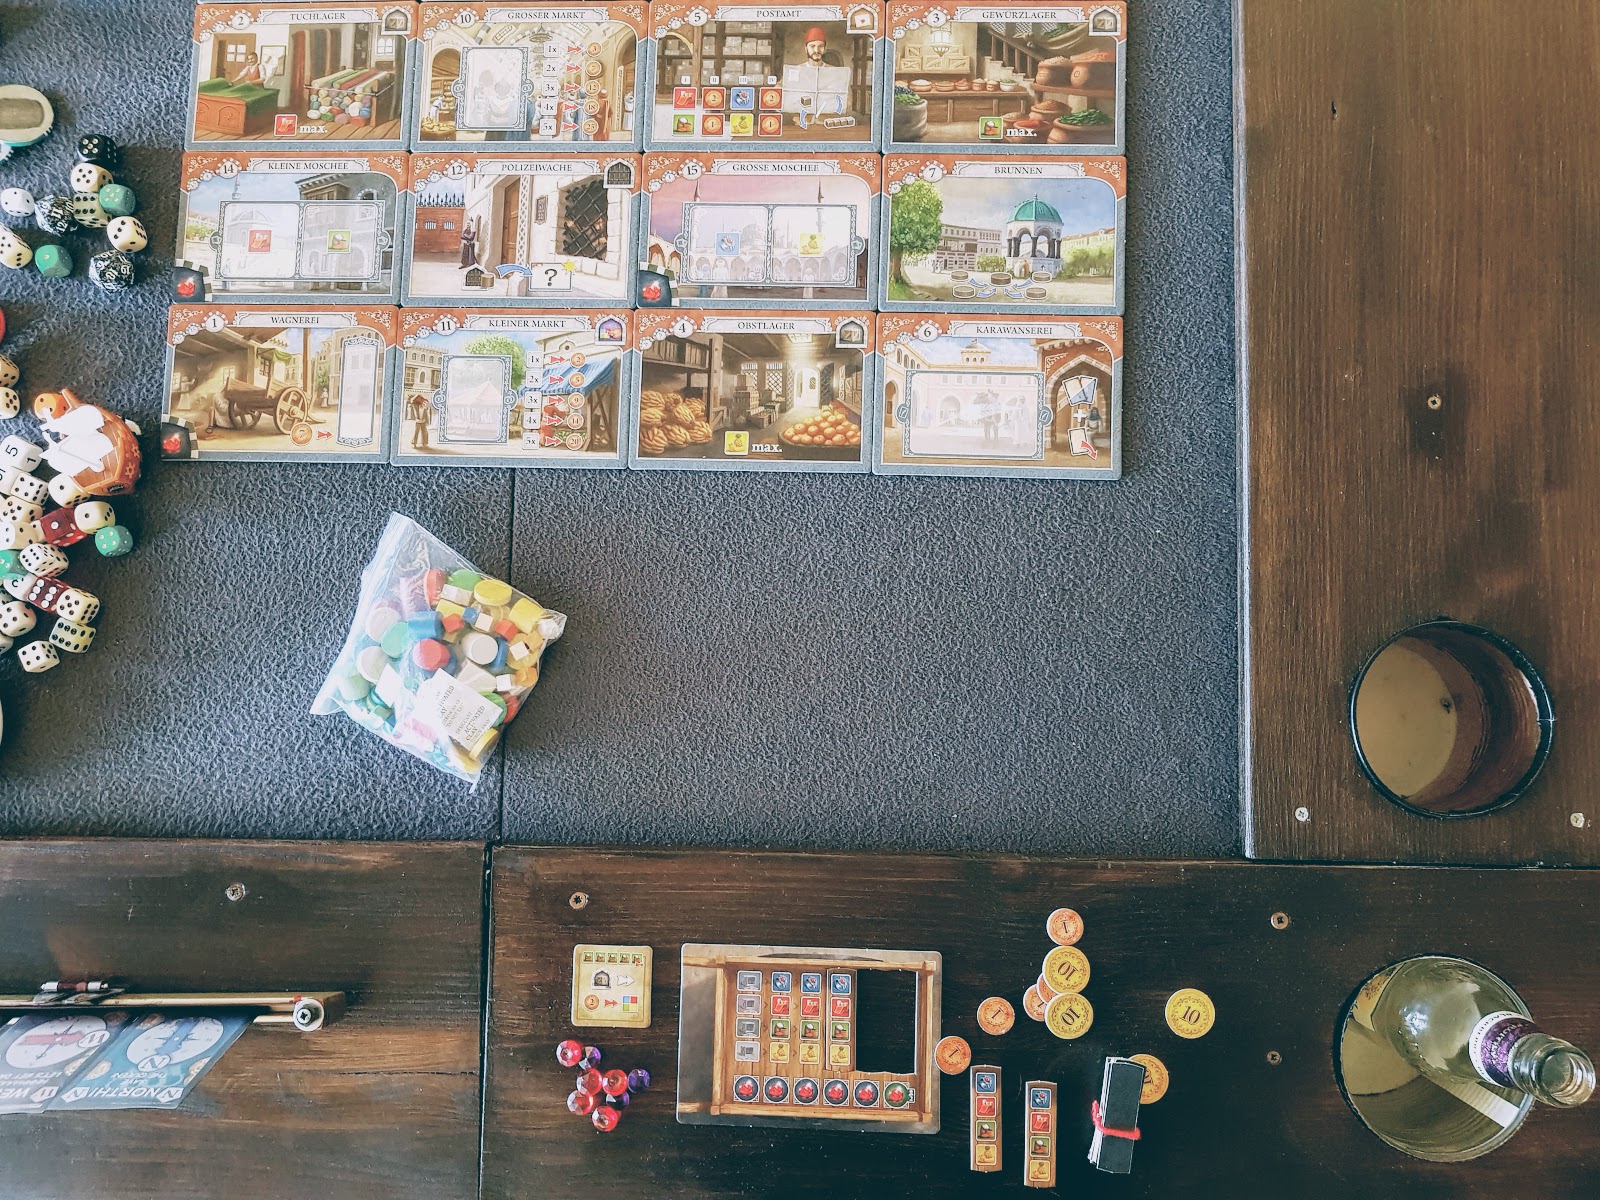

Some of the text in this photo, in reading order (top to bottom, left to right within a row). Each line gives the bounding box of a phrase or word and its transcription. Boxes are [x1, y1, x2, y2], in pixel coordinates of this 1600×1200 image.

[290, 12, 346, 21] TUCHLAGER
[459, 14, 472, 24] 10
[508, 11, 550, 19] GROSSER
[694, 13, 701, 22] 5
[933, 13, 940, 23] 3
[982, 10, 1057, 19] GEWÜRZLAGER
[237, 16, 244, 26] 2
[299, 124, 328, 134] max.
[1006, 126, 1037, 136] max.
[223, 165, 234, 174] 14
[451, 165, 463, 175] 12
[687, 166, 698, 175] 15
[929, 168, 936, 178] 7
[51, 206, 63, 219] 11
[56, 220, 68, 232] 12
[545, 268, 557, 286] ?
[212, 319, 217, 327] 1
[441, 321, 451, 330] 11
[738, 322, 795, 330] OBSTLAGER
[679, 324, 686, 333] 4
[924, 326, 931, 337] 6
[976, 326, 1053, 334] KARAWANSEREI
[5, 444, 18, 457] 5
[752, 443, 783, 452] max.
[435, 685, 455, 711] TIVATED
[466, 726, 478, 742] CLAY
[1062, 918, 1068, 934] 1
[1058, 962, 1077, 982] 10
[991, 1007, 1004, 1018] 1
[1061, 1005, 1080, 1026] 10
[1180, 1006, 1200, 1026] 10
[948, 1047, 962, 1058] 1
[140, 1057, 165, 1070] N
